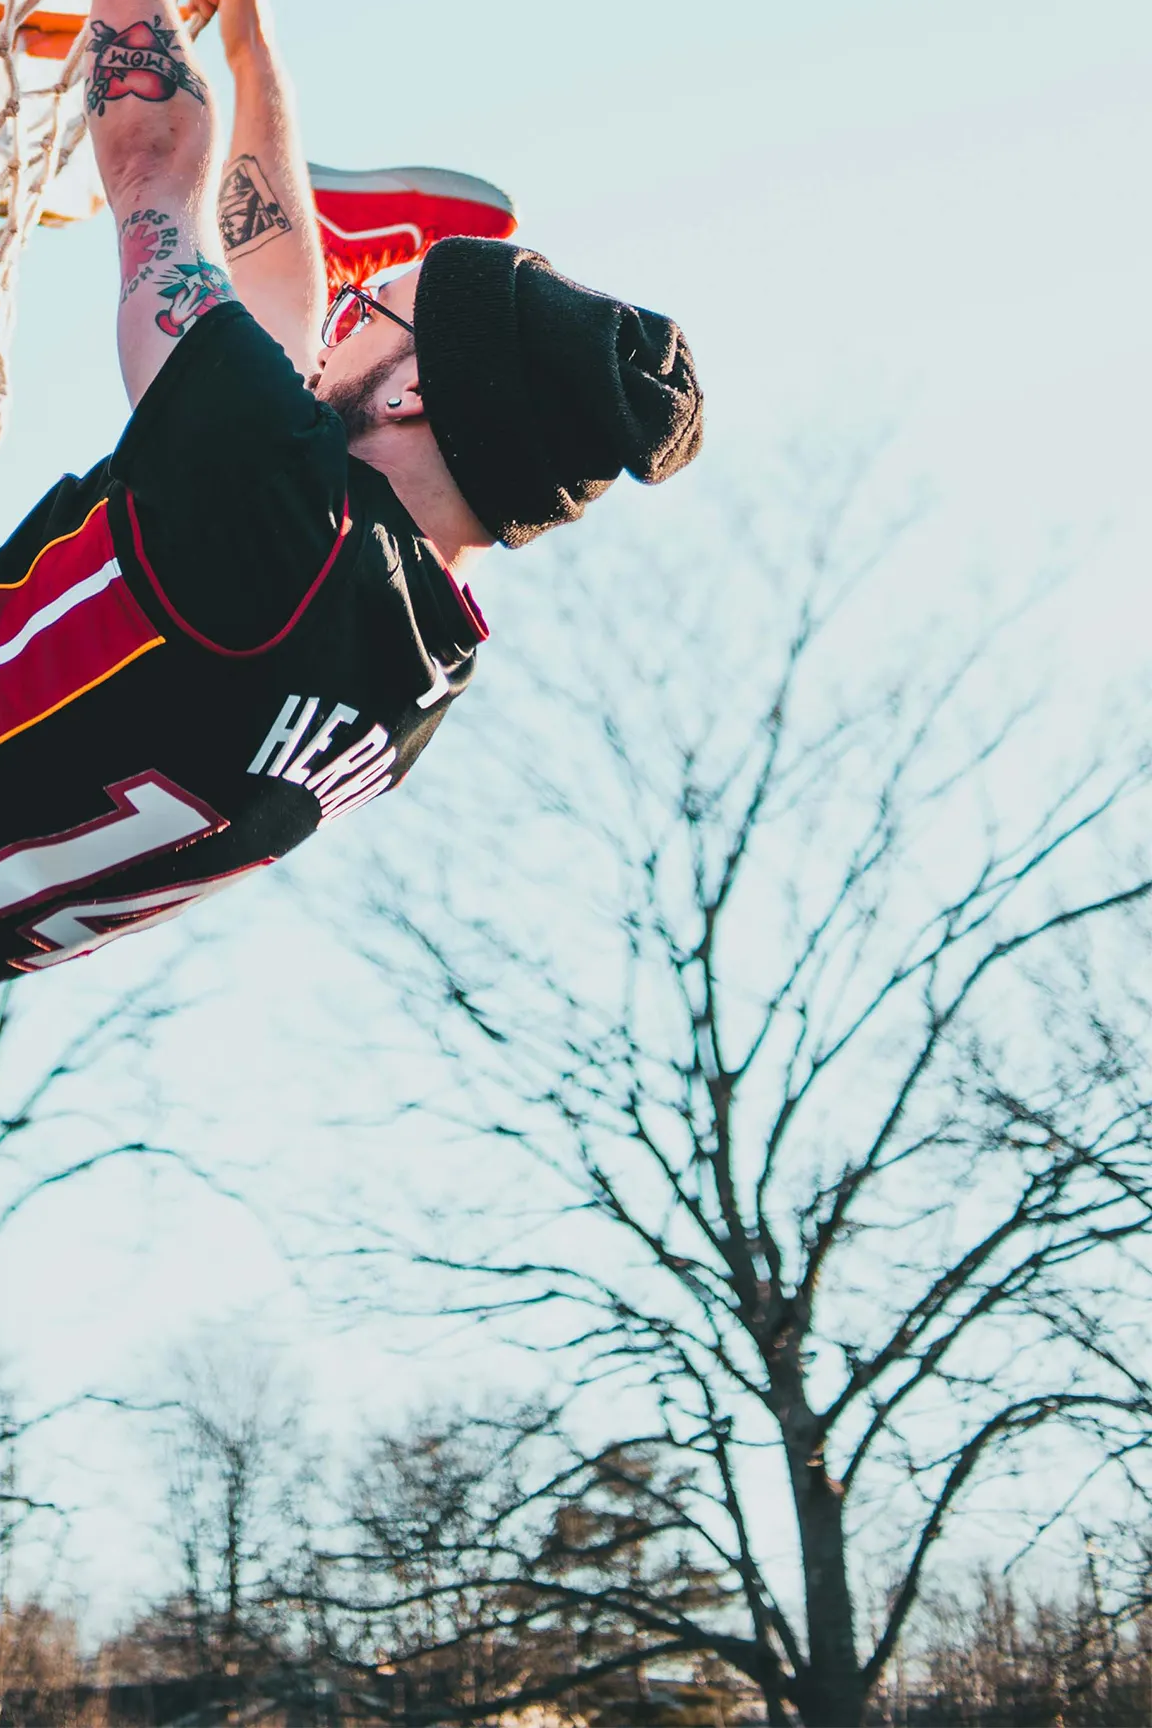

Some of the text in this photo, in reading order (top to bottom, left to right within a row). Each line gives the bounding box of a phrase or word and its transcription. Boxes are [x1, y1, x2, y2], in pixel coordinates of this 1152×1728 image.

[108, 50, 165, 71] MOM
[155, 227, 179, 260] RED
[246, 694, 397, 830] HERRO
